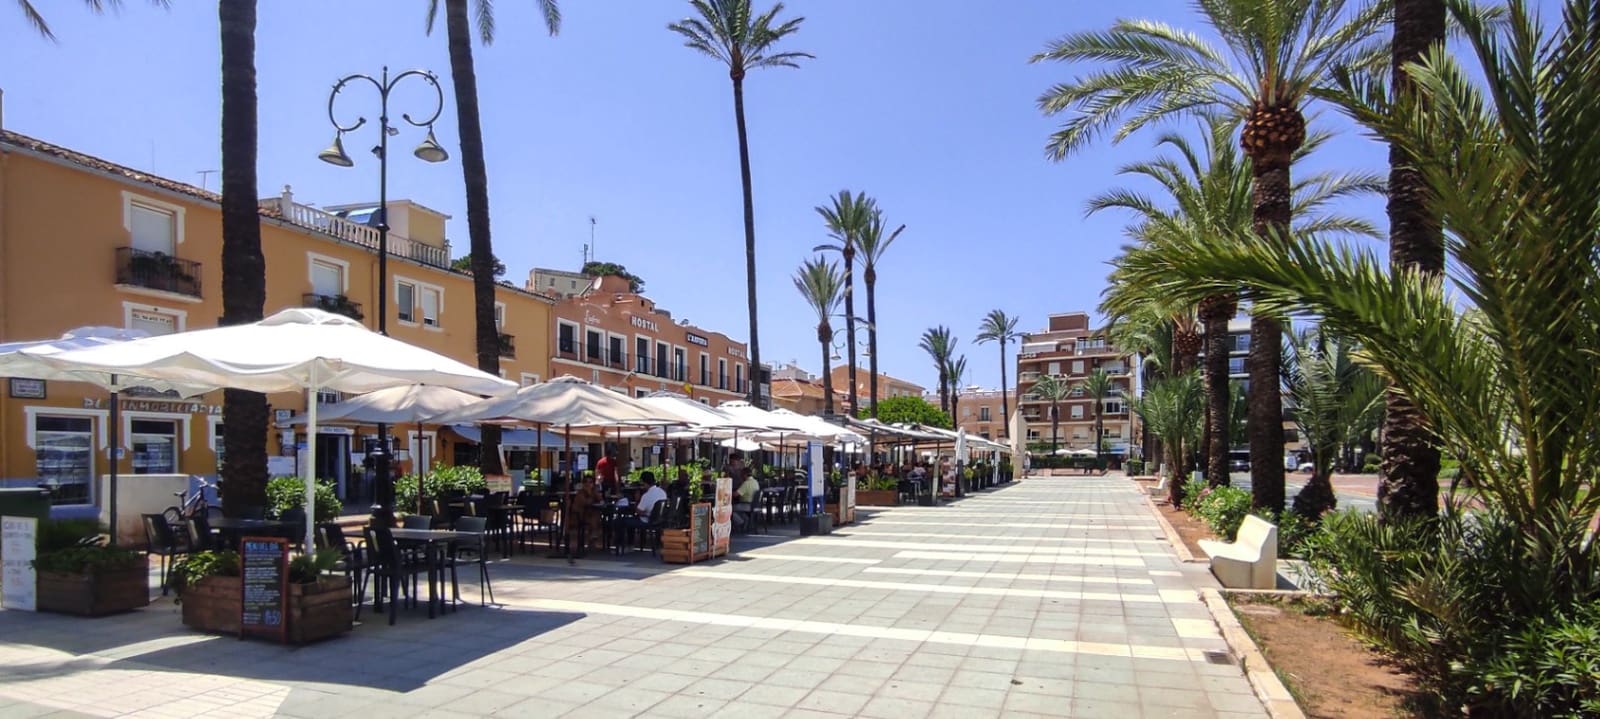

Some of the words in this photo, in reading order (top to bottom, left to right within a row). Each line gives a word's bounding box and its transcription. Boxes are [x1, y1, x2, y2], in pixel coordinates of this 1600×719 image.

[631, 316, 659, 333] HOSTAL
[728, 346, 746, 359] HOSTAL
[121, 400, 222, 414] INMOBILIARIA
